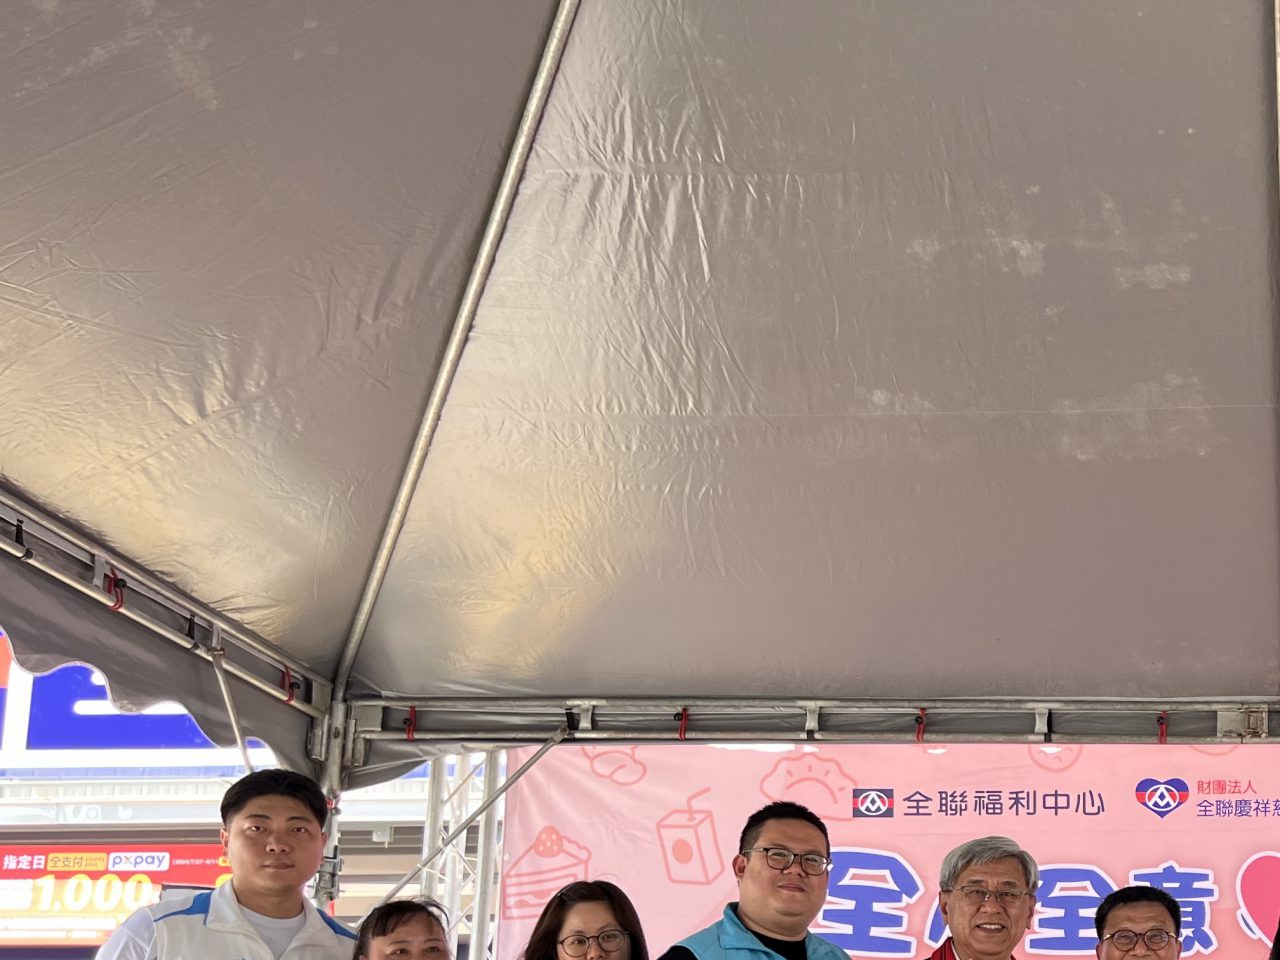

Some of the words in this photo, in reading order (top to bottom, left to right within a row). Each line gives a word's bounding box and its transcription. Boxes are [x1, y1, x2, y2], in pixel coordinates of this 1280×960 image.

[1197, 780, 1257, 794] 財團法人
[903, 789, 1105, 817] 全聯福利中心
[3, 855, 46, 869] 指定日
[50, 856, 83, 868] 全支付
[112, 854, 165, 868] pxpay
